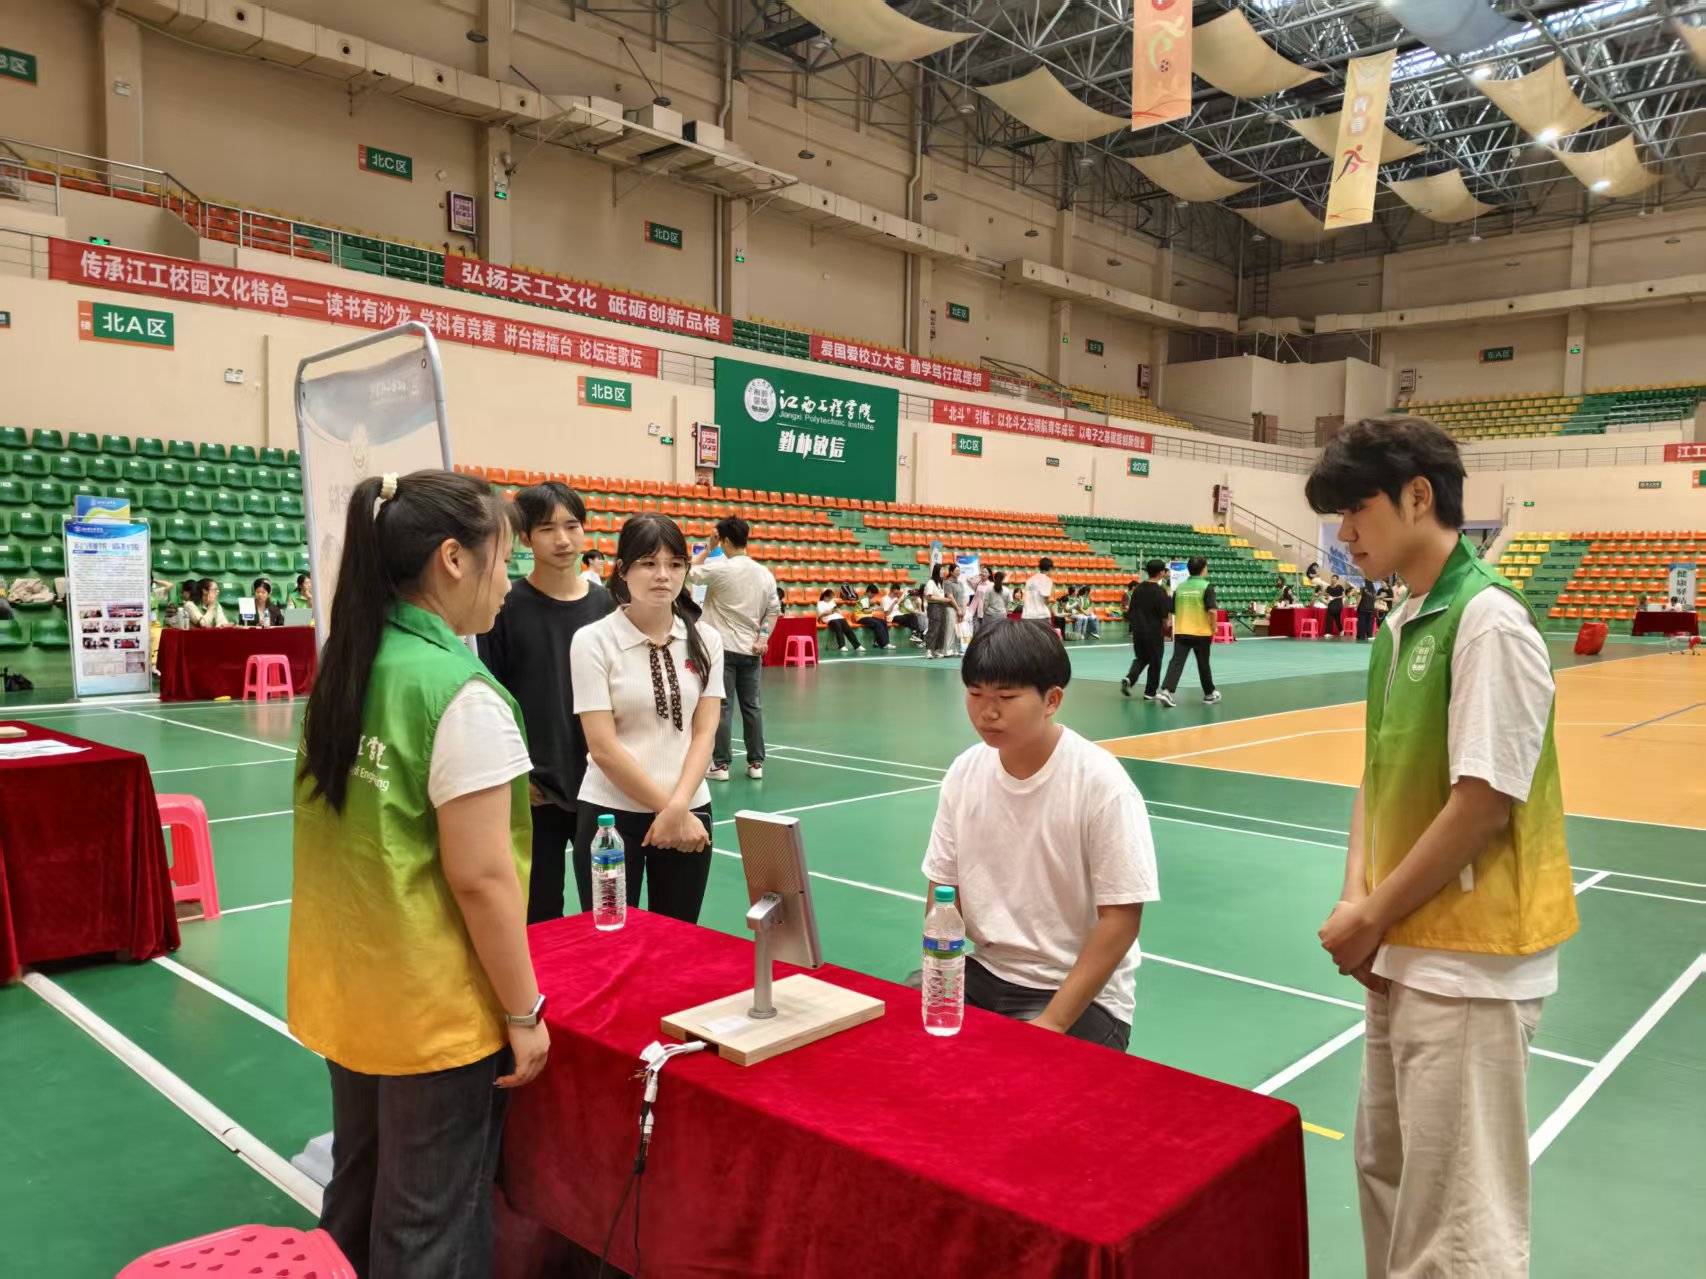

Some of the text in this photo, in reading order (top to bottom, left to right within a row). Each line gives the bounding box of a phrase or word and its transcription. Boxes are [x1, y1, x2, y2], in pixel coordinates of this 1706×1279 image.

[371, 152, 408, 174] 北C区
[653, 227, 679, 244] 北D区
[461, 261, 721, 336] 弘扬天工文化 砥砺创新品格
[102, 311, 167, 338] 北A区
[419, 308, 497, 344] 学科有竞赛
[503, 323, 573, 358] 讲台摆擂台
[579, 339, 643, 370] 论坛连歌坛
[820, 339, 982, 387] 爱国爱校立大志 勤学笃行筑理想
[591, 383, 626, 402] 北B区
[779, 389, 877, 423] 江西工程学院
[778, 410, 875, 431] Jiangxi Polytechnic Institute
[959, 438, 980, 451] 北C区
